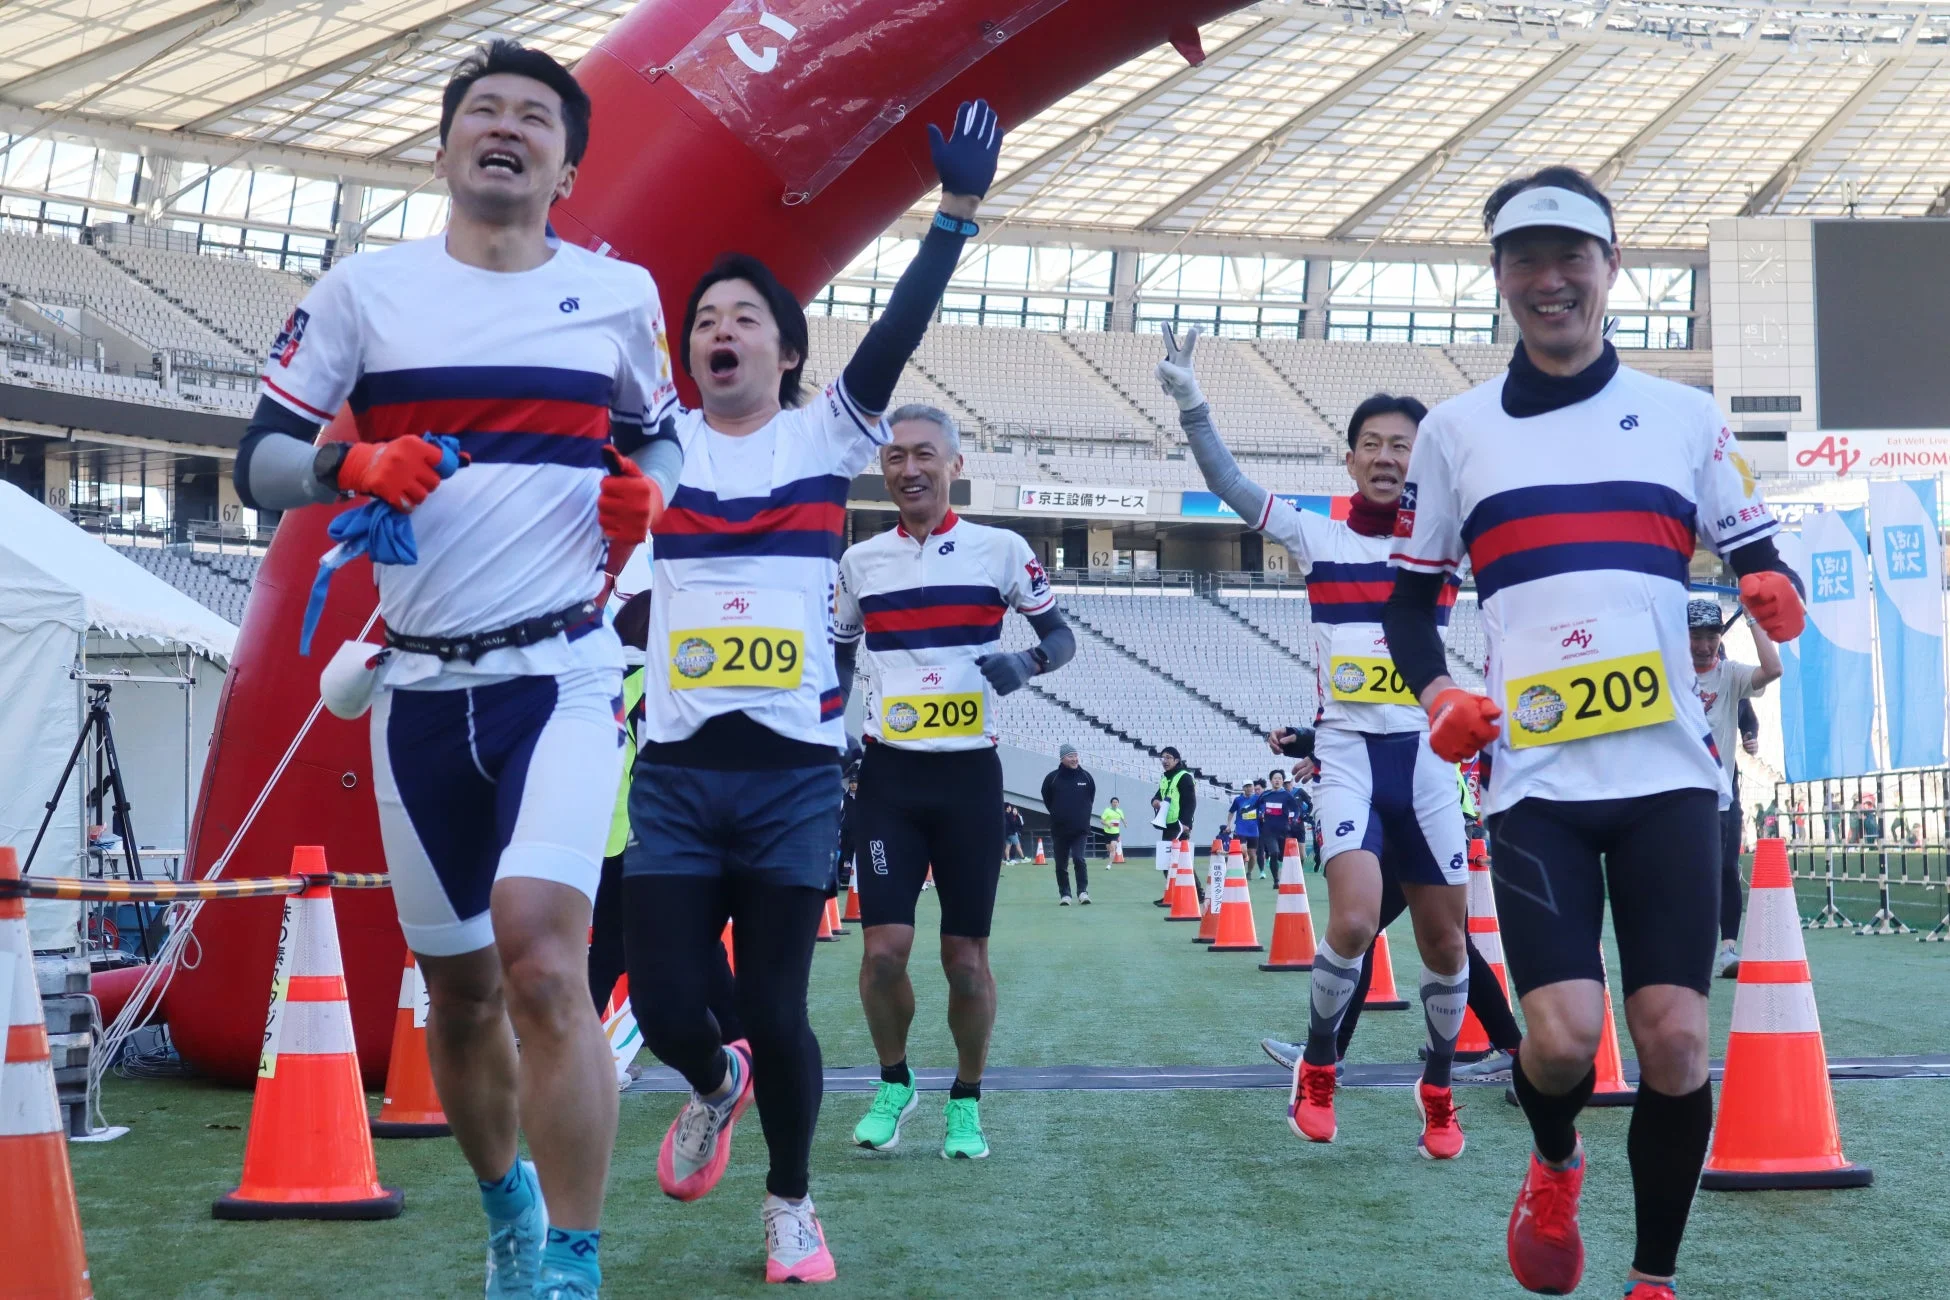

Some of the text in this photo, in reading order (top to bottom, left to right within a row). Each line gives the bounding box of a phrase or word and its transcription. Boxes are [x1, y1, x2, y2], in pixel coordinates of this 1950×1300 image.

[1887, 436, 1902, 446] Eat
[1904, 436, 1925, 446] Well
[1869, 451, 1950, 469] AJINOM
[49, 487, 67, 507] 68
[1038, 491, 1145, 509] 京王設備サービス
[223, 504, 240, 522] 67
[1716, 515, 1737, 532] NO
[1091, 551, 1110, 568] 62
[1267, 555, 1284, 570] 61
[722, 636, 798, 674] 209
[1369, 665, 1407, 694] 20
[1570, 665, 1660, 721] 209
[923, 699, 978, 729] 209
[870, 839, 889, 875] 2XU
